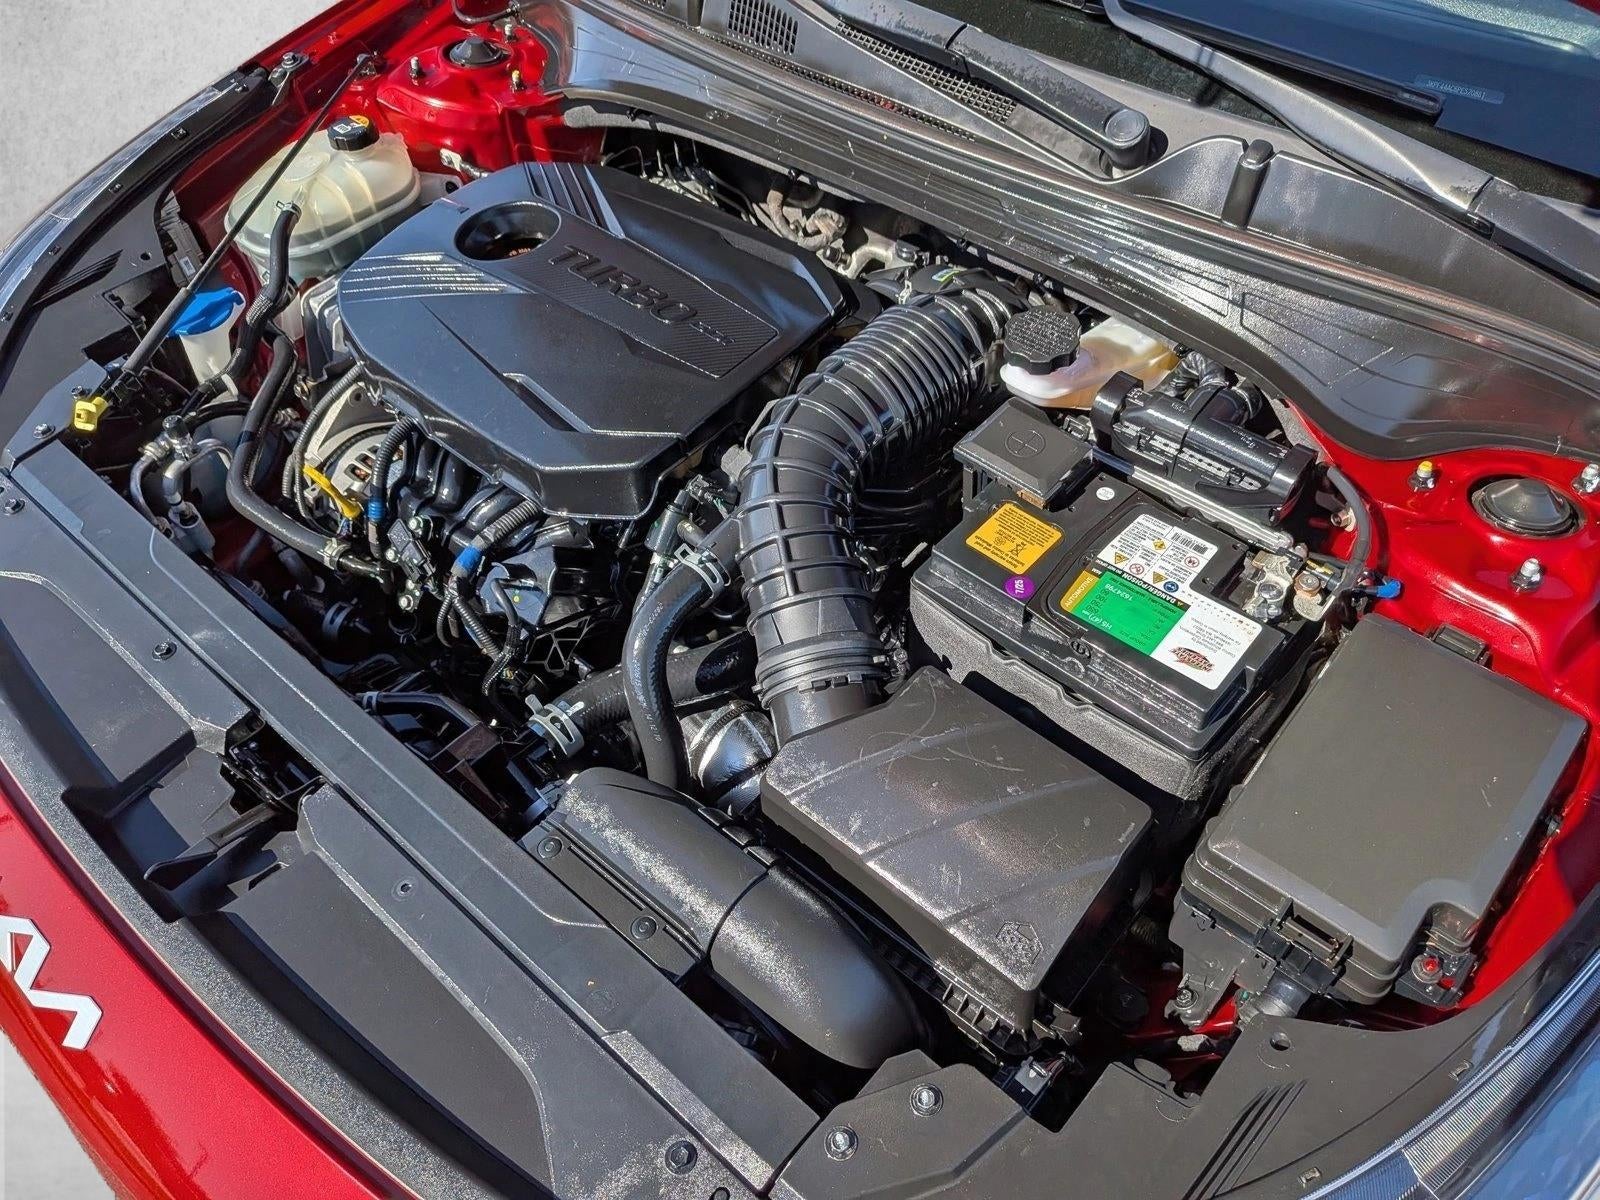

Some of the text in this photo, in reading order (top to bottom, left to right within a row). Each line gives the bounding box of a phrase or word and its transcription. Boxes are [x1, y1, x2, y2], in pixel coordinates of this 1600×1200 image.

[547, 243, 698, 324] TURBO
[1014, 579, 1026, 595] 7/25
[1062, 576, 1093, 607] AUTOMOTIVE
[1103, 582, 1134, 601] 1624798
[1120, 572, 1177, 603] DANGER/POISON
[1090, 599, 1103, 607] 750
[1094, 593, 1107, 602] 100
[1085, 604, 1099, 613] 650
[1087, 612, 1103, 623] (47)
[1099, 619, 1113, 629] H5
[1168, 647, 1213, 673] INTERSTATE
[1175, 645, 1214, 668] BATTERIES
